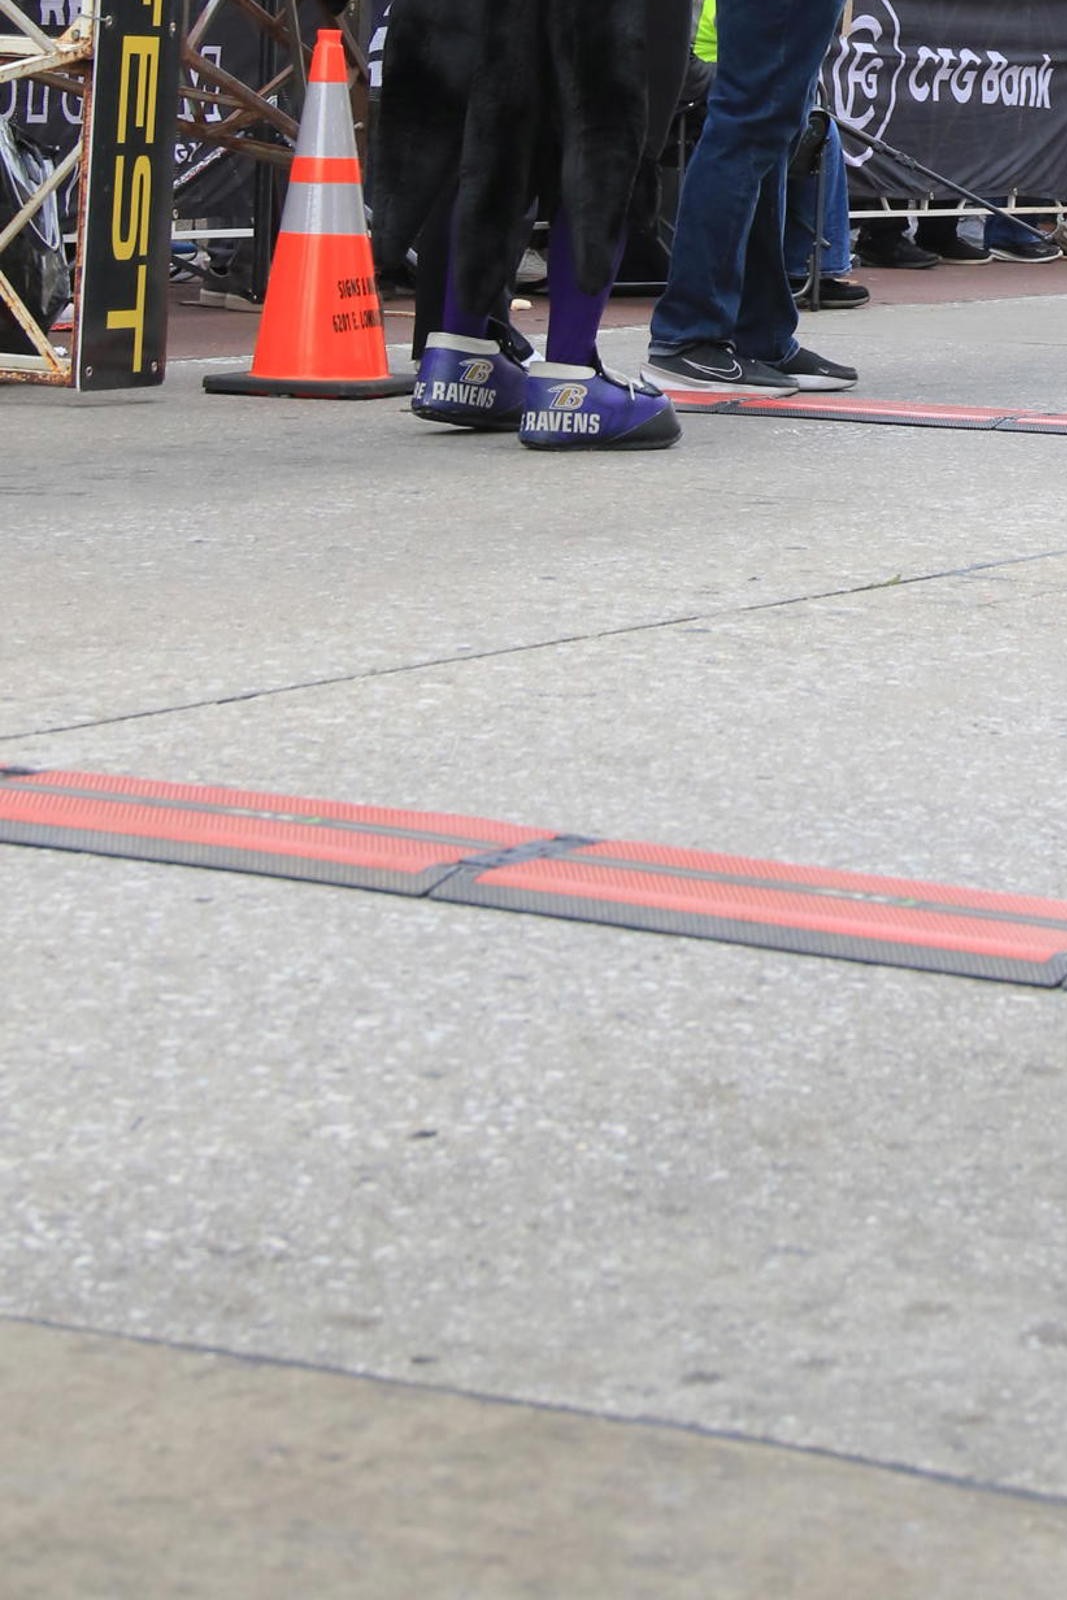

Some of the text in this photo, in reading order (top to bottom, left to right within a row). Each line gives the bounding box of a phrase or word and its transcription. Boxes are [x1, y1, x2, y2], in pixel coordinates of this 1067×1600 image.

[908, 45, 1054, 109] CFG Bank
[432, 380, 497, 409] RAVENS
[524, 411, 601, 435] RAVENS
